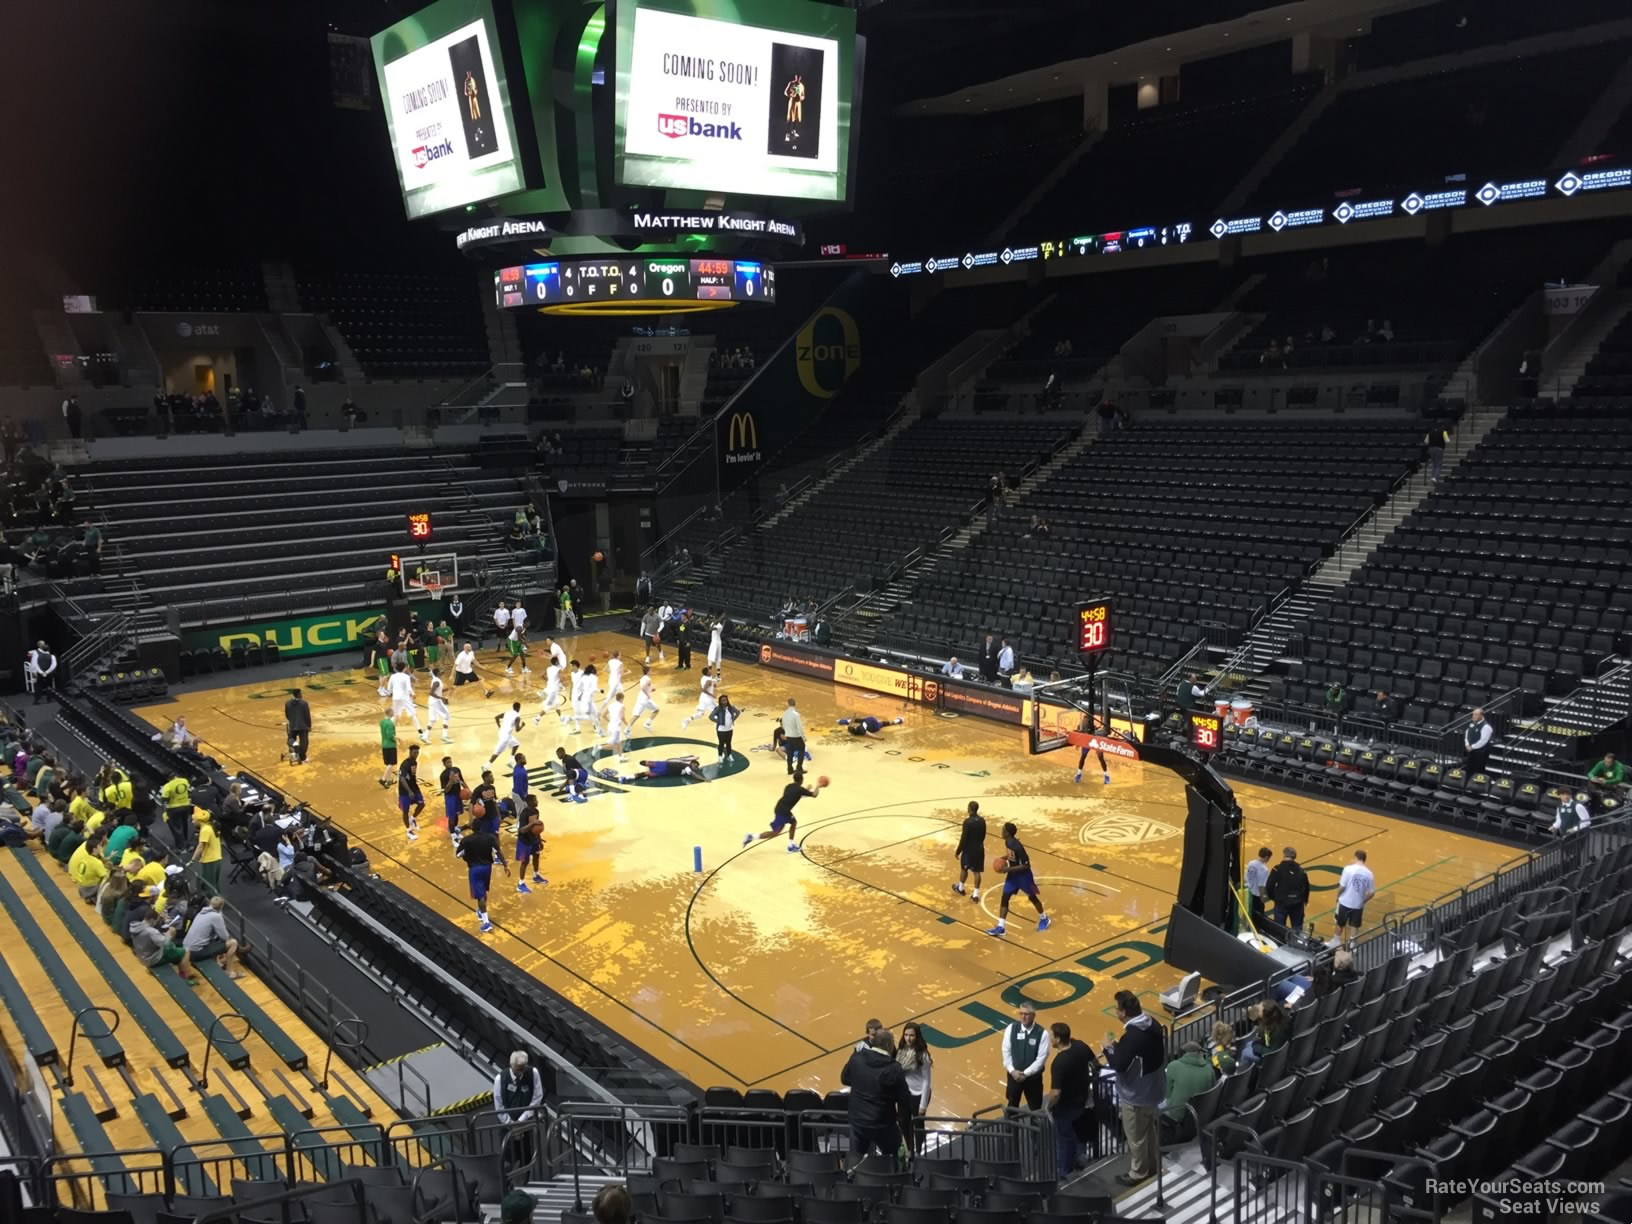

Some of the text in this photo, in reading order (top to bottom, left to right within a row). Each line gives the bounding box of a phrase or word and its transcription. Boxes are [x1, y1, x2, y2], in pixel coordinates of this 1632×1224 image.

[664, 53, 758, 86] COMING SOON!
[402, 78, 450, 114] COMING SOON!
[676, 97, 732, 116] PRESENTED BY
[1584, 169, 1632, 180] OREGON
[1502, 180, 1546, 190] OREGON
[1583, 176, 1631, 185] COMMUNITY
[1425, 190, 1466, 200] OREGON
[1502, 187, 1546, 195] COMMUNITY
[1355, 200, 1393, 210] OREGON
[1288, 210, 1323, 218] OREGON
[634, 214, 795, 236] MATTHEW KNIGHT ARENA
[1228, 218, 1260, 226] OREGON
[468, 225, 500, 240] KNIGHT
[502, 221, 545, 235] ARENA
[1176, 224, 1191, 234] T.O.
[1138, 238, 1143, 246] 0
[1180, 234, 1186, 242] F
[1080, 246, 1085, 254] 0
[1044, 252, 1050, 260] F
[565, 268, 572, 278] 4
[580, 266, 620, 277] T.O. T.O.
[629, 266, 636, 276] 4
[650, 263, 685, 274] Oregon
[698, 262, 728, 274] 44:59
[537, 282, 546, 300] 0
[566, 286, 574, 296] 0
[588, 284, 617, 295] F F
[630, 283, 638, 294] 0
[662, 278, 674, 296] 0
[746, 280, 754, 296] 0
[194, 324, 220, 336] at&t
[637, 342, 687, 352] 120 121
[737, 452, 755, 463] lovin'
[756, 452, 761, 461] it
[412, 522, 428, 536] 30
[1081, 606, 1106, 622] 44:58
[1084, 622, 1102, 647] 30
[862, 671, 876, 682] YOU
[895, 678, 907, 690] WE
[1192, 716, 1218, 730] 44:58
[1198, 729, 1212, 745] 30
